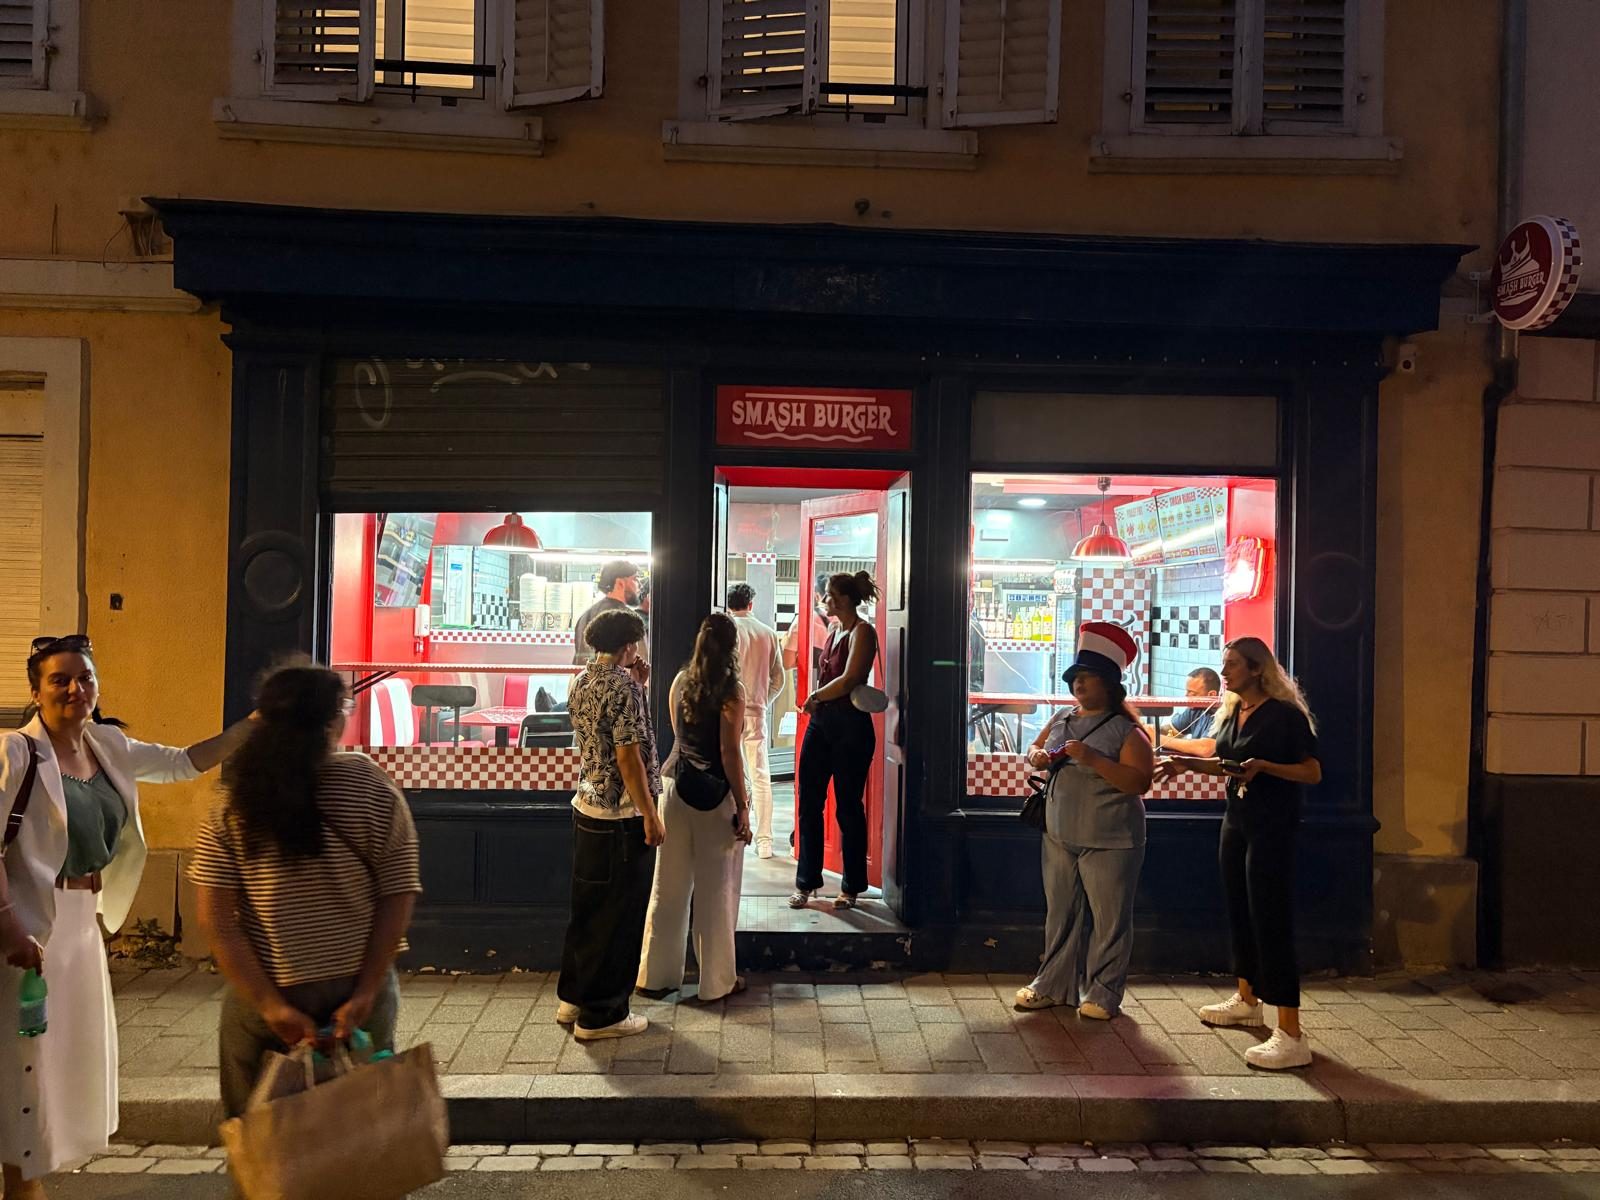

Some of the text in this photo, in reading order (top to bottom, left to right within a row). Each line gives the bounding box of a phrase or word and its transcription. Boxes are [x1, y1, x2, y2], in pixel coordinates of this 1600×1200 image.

[1520, 271, 1545, 288] BURGER
[732, 400, 898, 436] SMASH BURGER
